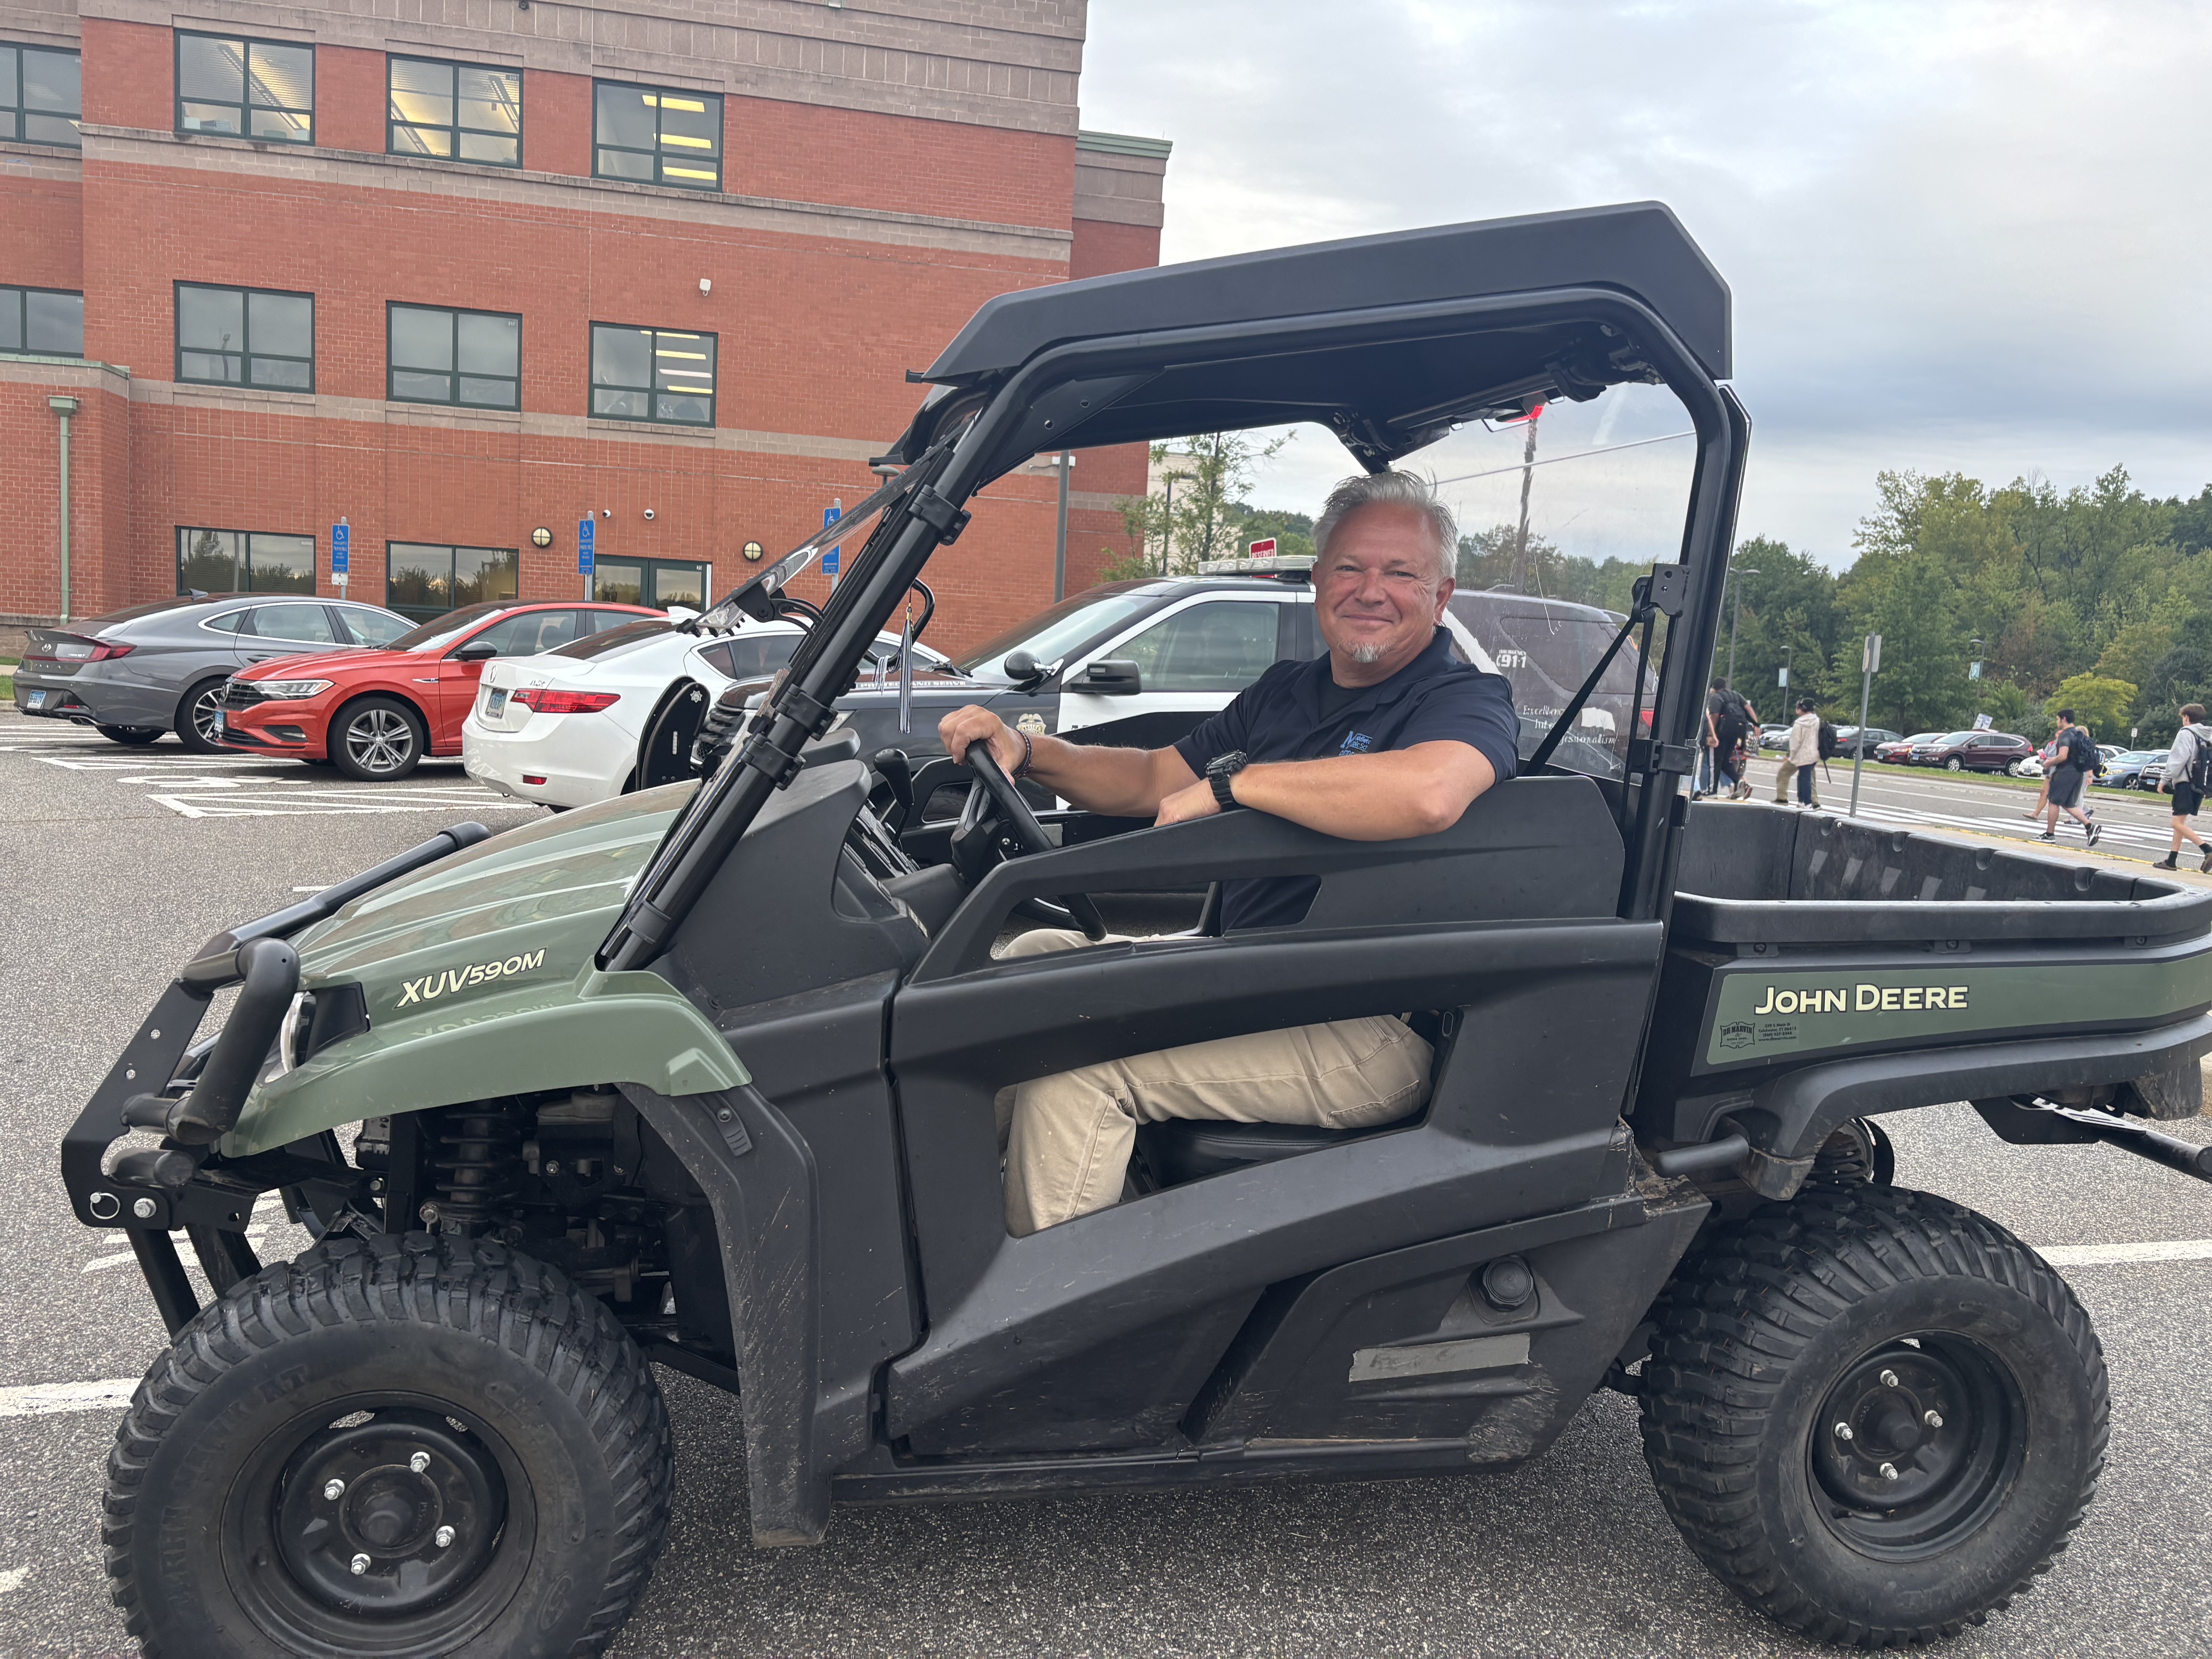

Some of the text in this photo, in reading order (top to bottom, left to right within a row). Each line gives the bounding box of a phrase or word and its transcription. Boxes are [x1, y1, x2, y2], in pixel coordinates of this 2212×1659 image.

[1523, 705, 1565, 716] Excellenc
[393, 947, 548, 1010] XUV590M
[1731, 1025, 1752, 1034] MARVIN
